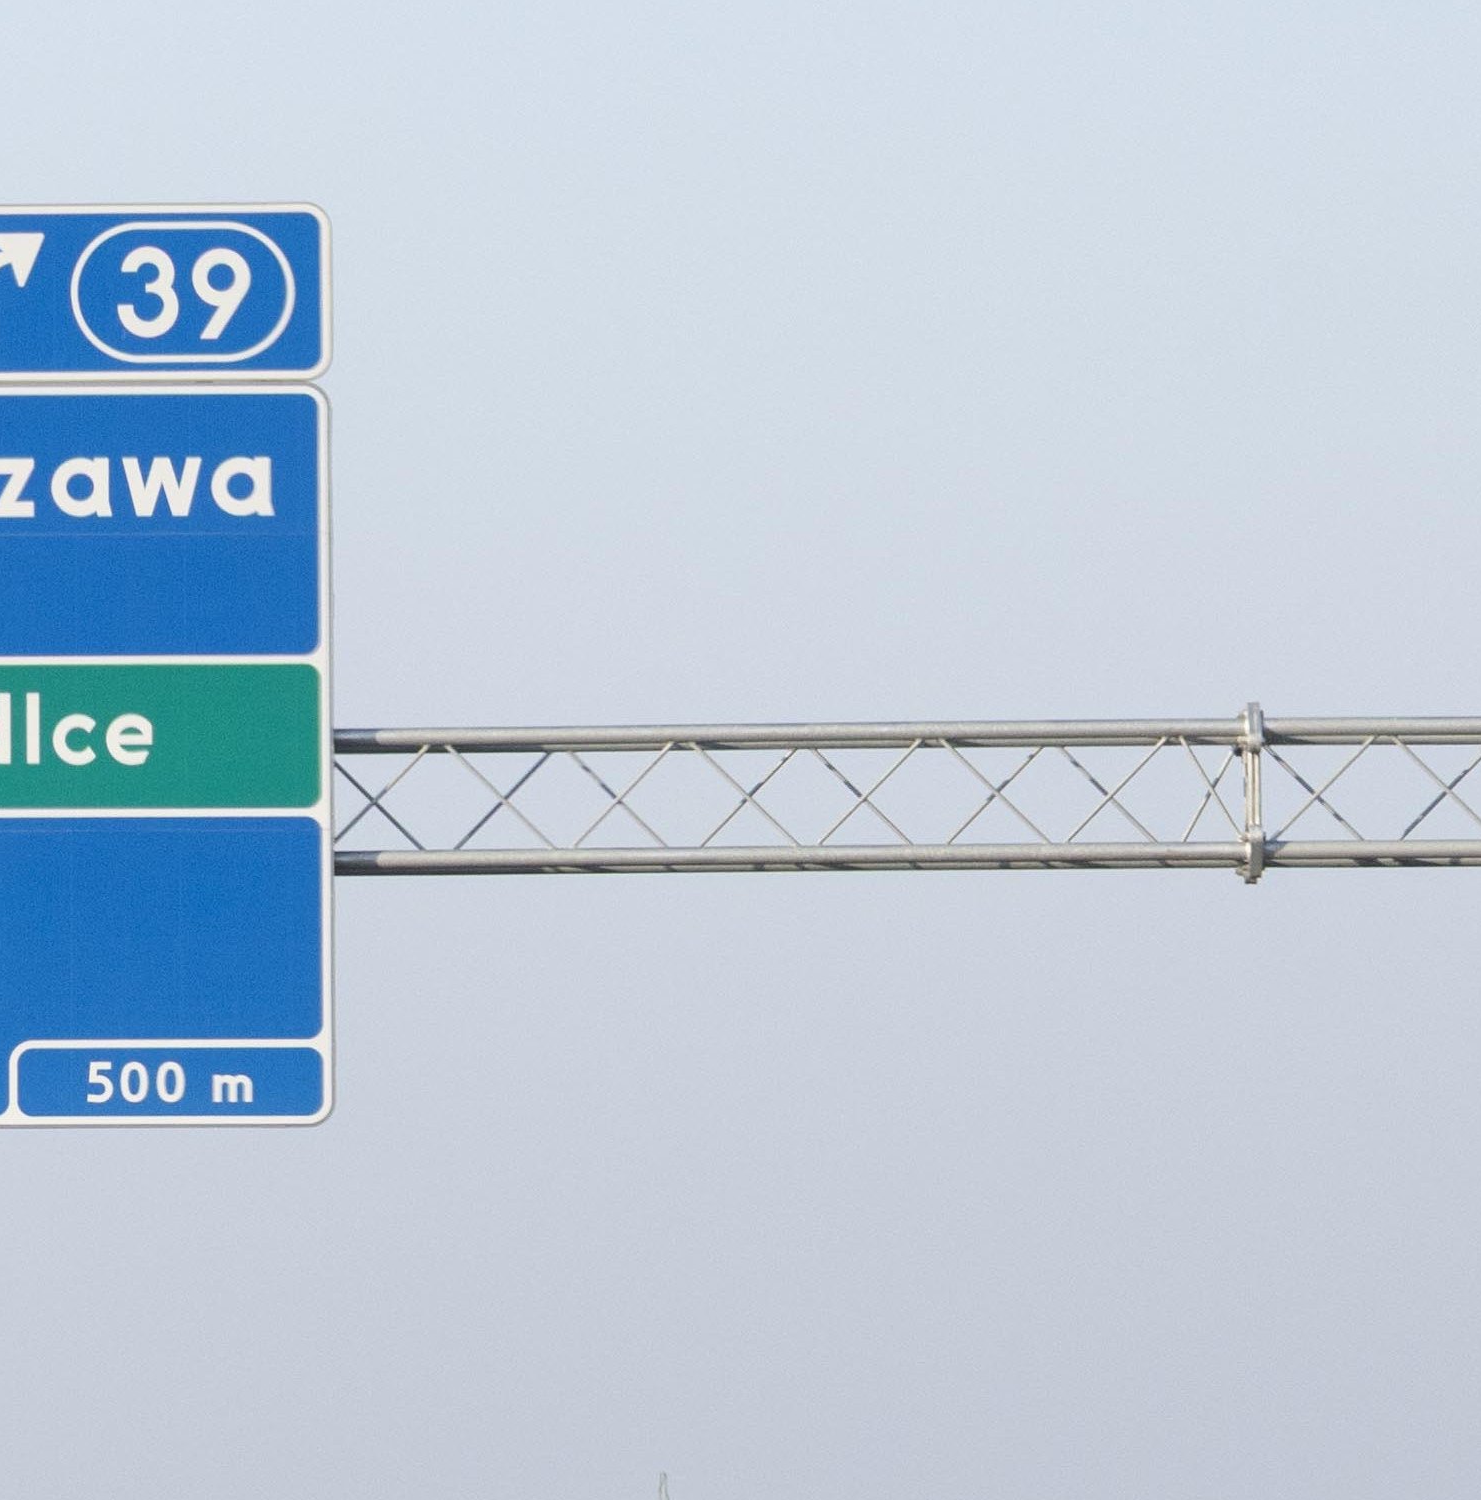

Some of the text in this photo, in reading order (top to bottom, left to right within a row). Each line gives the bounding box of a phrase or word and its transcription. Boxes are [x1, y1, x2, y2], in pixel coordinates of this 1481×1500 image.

[115, 245, 254, 342] 39
[85, 1060, 254, 1105] 500 m
